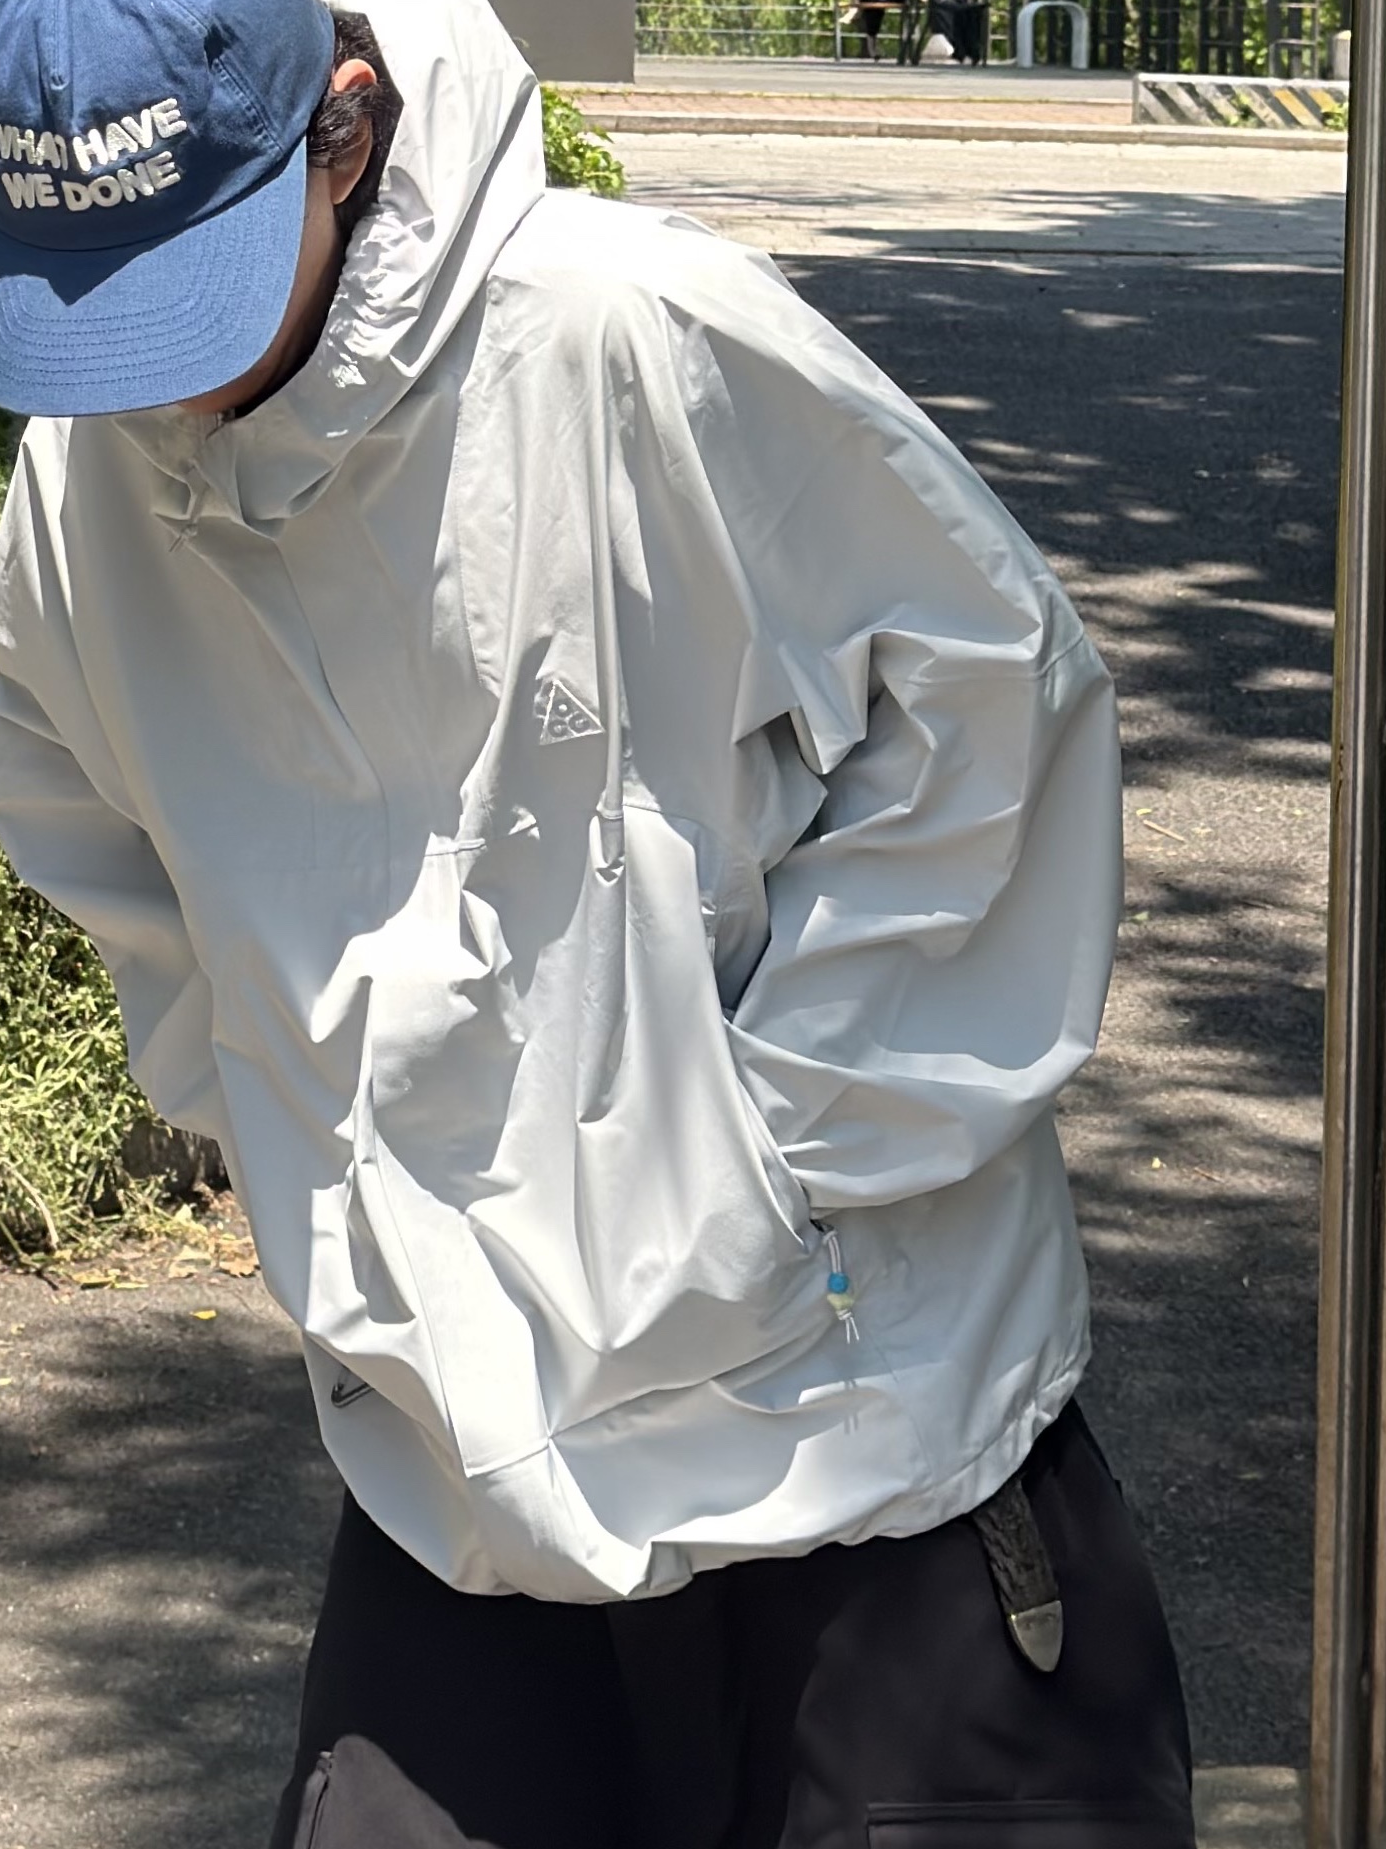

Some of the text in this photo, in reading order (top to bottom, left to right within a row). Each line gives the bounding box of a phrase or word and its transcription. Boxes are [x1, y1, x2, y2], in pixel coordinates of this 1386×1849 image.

[72, 97, 188, 172] HAVE
[1, 150, 182, 212] WE DONE
